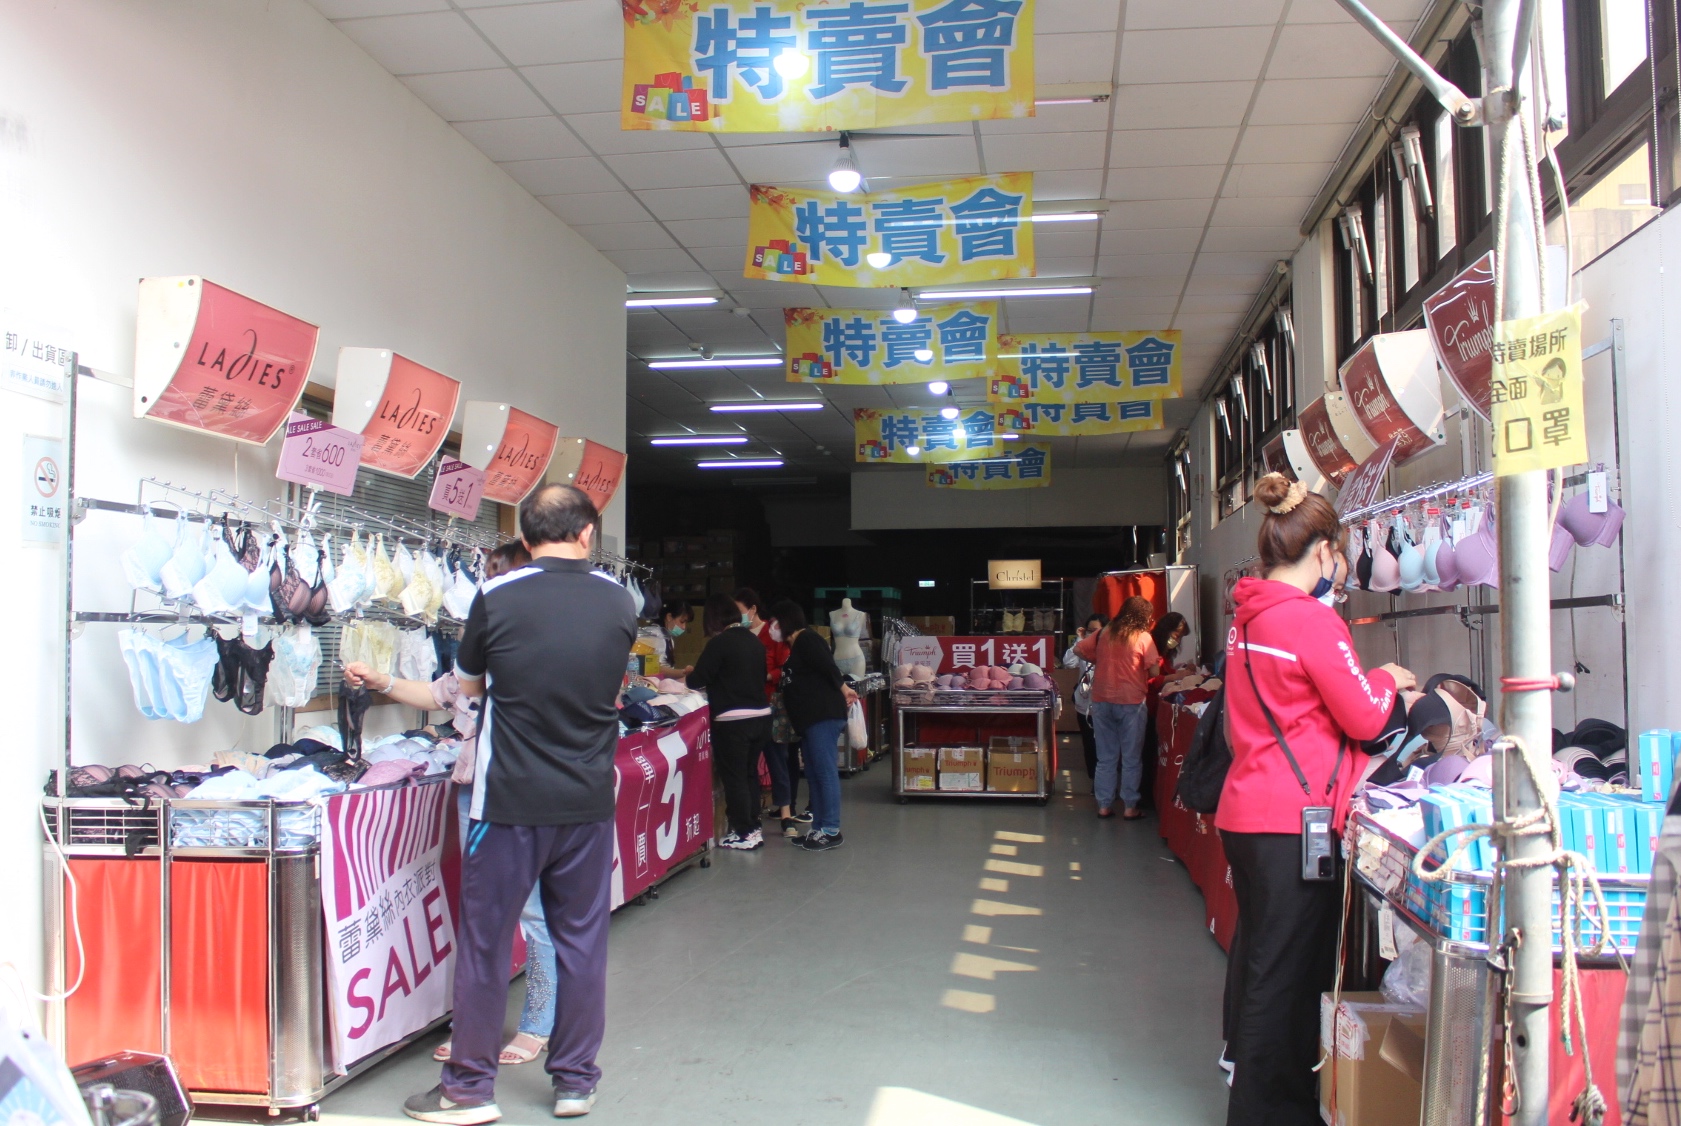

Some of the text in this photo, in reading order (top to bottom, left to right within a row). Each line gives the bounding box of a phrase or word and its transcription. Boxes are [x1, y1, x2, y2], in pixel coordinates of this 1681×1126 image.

[694, 0, 1023, 100] 特賣會
[635, 95, 701, 116] SALE
[796, 187, 1023, 267] 特賣會
[755, 254, 802, 271] SALE
[823, 310, 990, 368] 特賣會
[197, 328, 286, 390] LADIES
[793, 363, 829, 376] SALE
[1021, 337, 1175, 389] 特賣會
[993, 385, 1025, 396] SALE
[1491, 375, 1527, 404] 全面
[297, 423, 310, 433] SALE
[310, 420, 323, 431] SALE
[380, 388, 437, 435] LADIES
[999, 417, 1029, 428] SALE
[881, 410, 995, 451] 特賣會
[498, 433, 538, 471] LADIES
[948, 447, 1046, 480] 特賣會
[30, 520, 38, 528] NO
[996, 569, 1034, 582] Christel
[904, 645, 937, 659] Triumph
[952, 638, 1047, 669] 買1送1
[993, 766, 1036, 778] Triumph
[685, 813, 700, 843] 折起
[338, 858, 437, 965] 蕾黛絲內衣派對
[346, 885, 453, 1040] SALE
